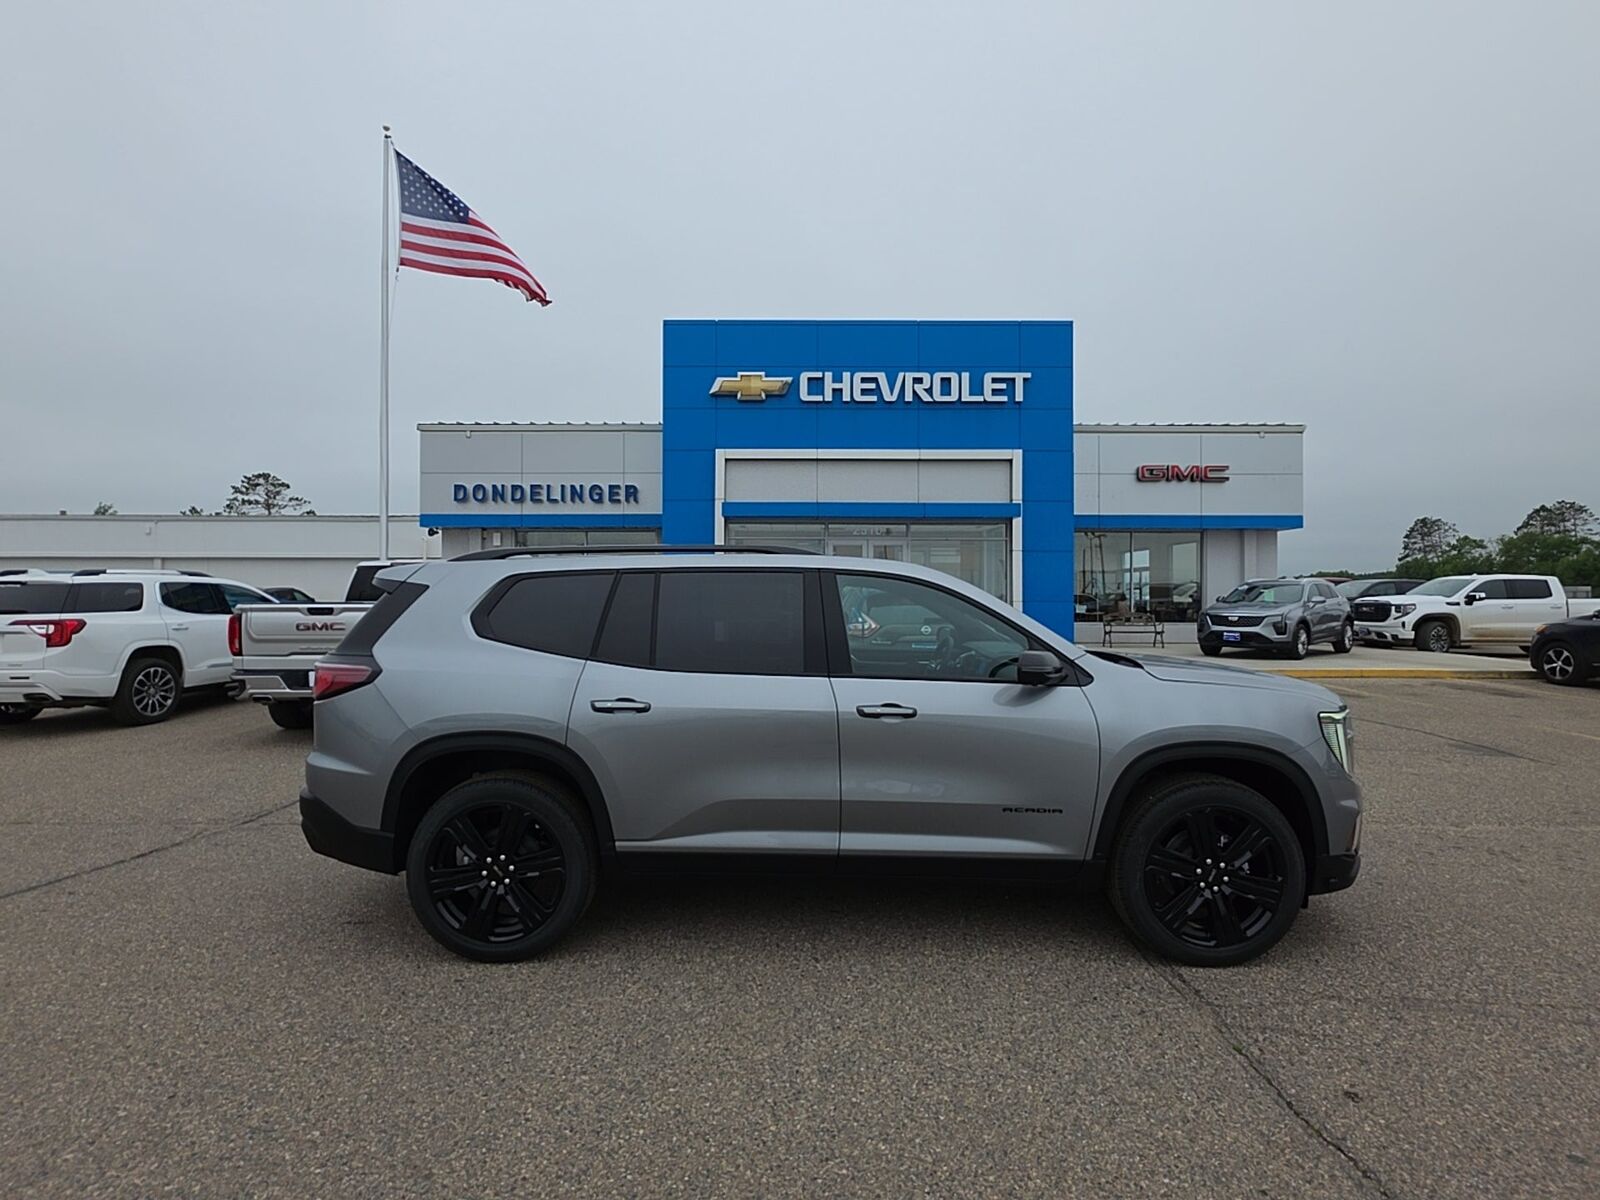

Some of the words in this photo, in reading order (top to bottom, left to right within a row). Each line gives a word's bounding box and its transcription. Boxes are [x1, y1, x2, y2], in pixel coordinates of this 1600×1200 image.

[800, 371, 1032, 402] CHEVROLET
[1136, 464, 1230, 483] GMC
[453, 484, 640, 504] DONDELINGER
[295, 622, 346, 631] GMC
